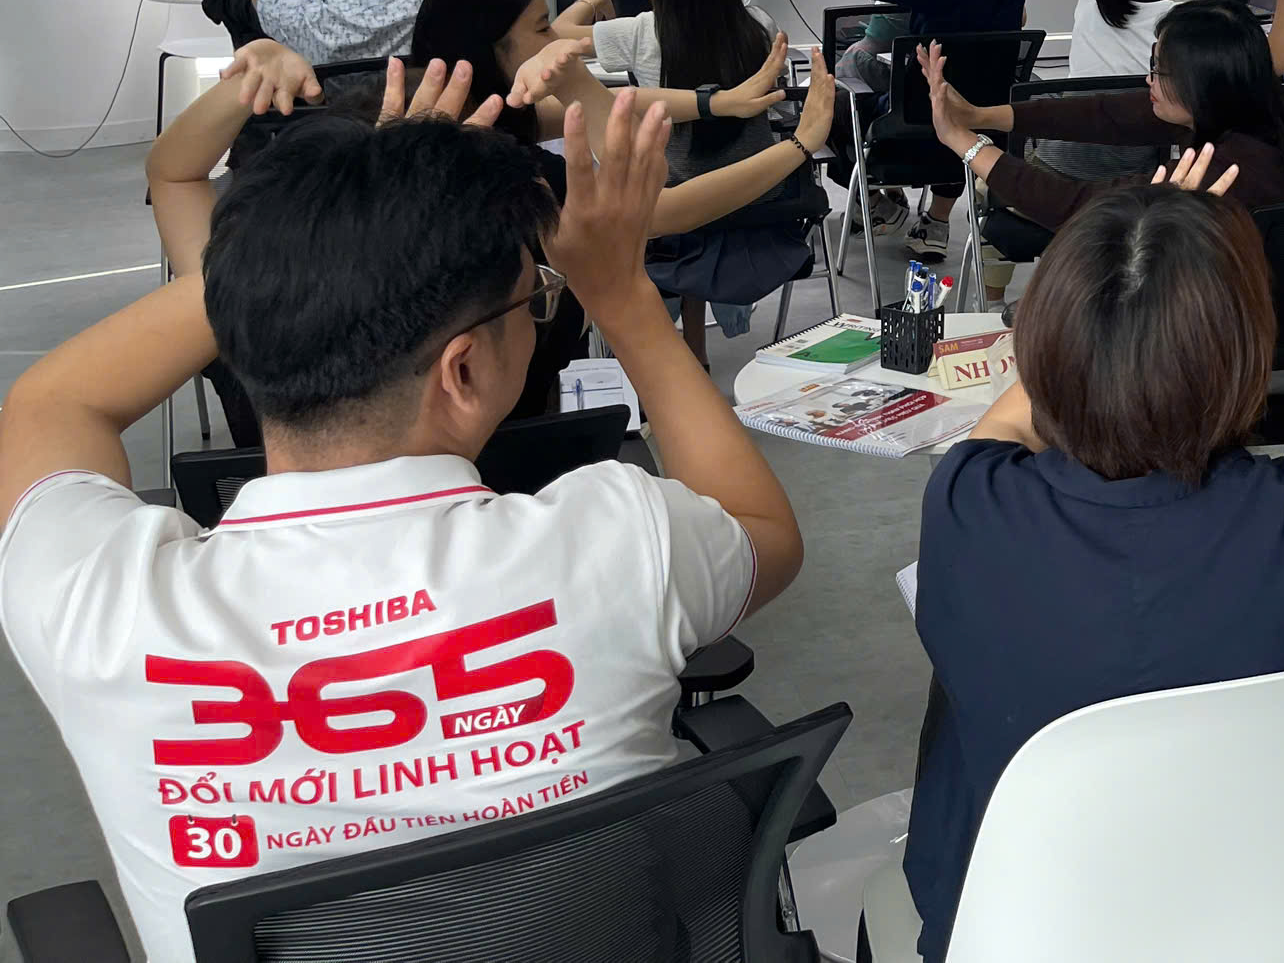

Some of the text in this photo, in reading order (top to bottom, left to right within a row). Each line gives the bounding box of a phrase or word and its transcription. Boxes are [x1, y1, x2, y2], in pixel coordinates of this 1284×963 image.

[938, 342, 959, 353] SAM
[271, 588, 437, 646] TOSHIBA
[145, 598, 575, 766] 365
[453, 704, 526, 735] NGÀY
[158, 719, 587, 805] ĐỔI MỚI LINH HOẠT
[186, 827, 242, 860] 30
[266, 825, 336, 849] NGÀY
[402, 814, 456, 828] TIÊN
[463, 793, 534, 822] HOÀN
